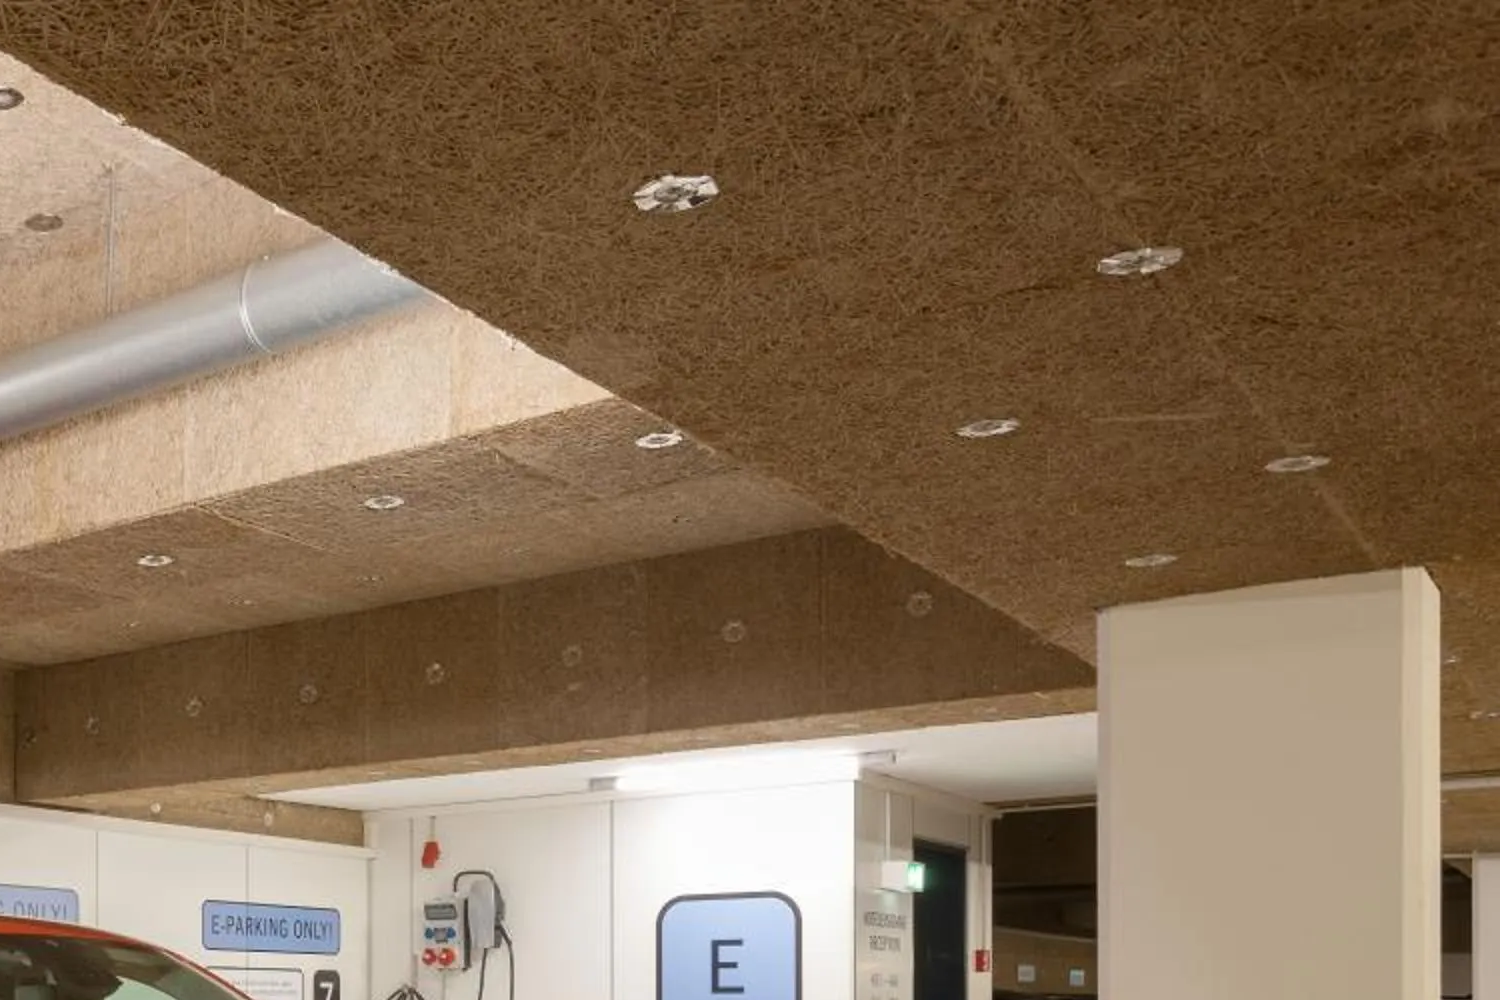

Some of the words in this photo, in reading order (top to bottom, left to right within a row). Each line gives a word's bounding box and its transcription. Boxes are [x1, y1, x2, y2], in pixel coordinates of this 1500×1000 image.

[211, 914, 289, 939] E-PARKING
[293, 919, 334, 941] ONLY!
[711, 939, 745, 995] E
